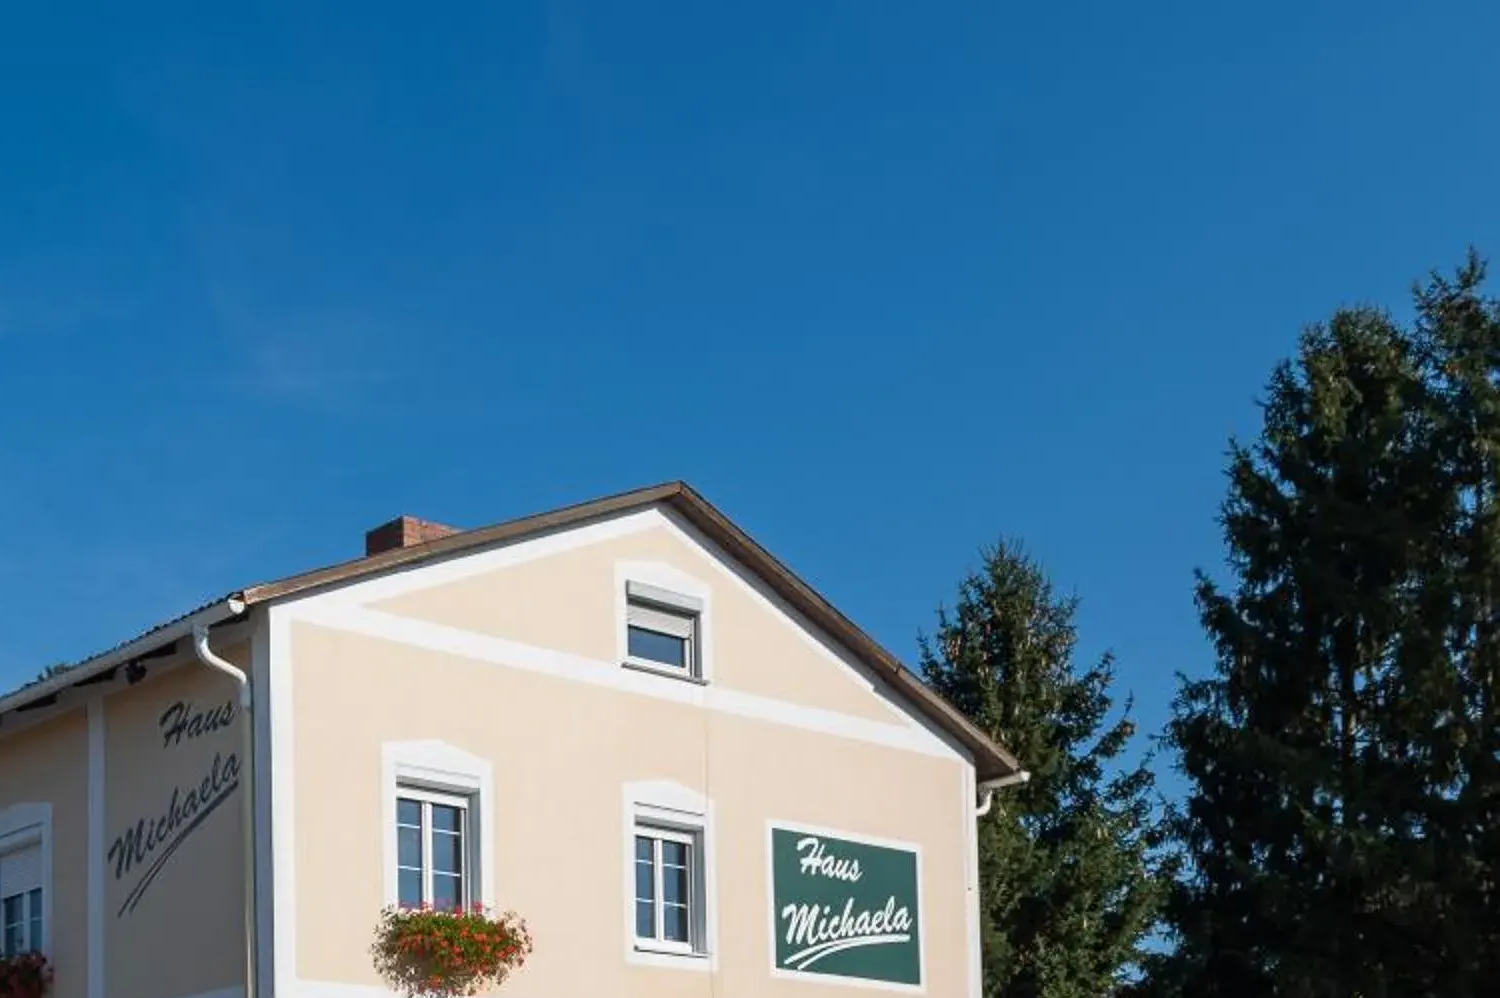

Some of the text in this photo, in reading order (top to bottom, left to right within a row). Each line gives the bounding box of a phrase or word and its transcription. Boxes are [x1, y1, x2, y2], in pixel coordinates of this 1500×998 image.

[159, 701, 237, 749] Haus
[107, 751, 242, 881] Michaela
[796, 837, 863, 882] Haus
[781, 895, 914, 945] Michaela
